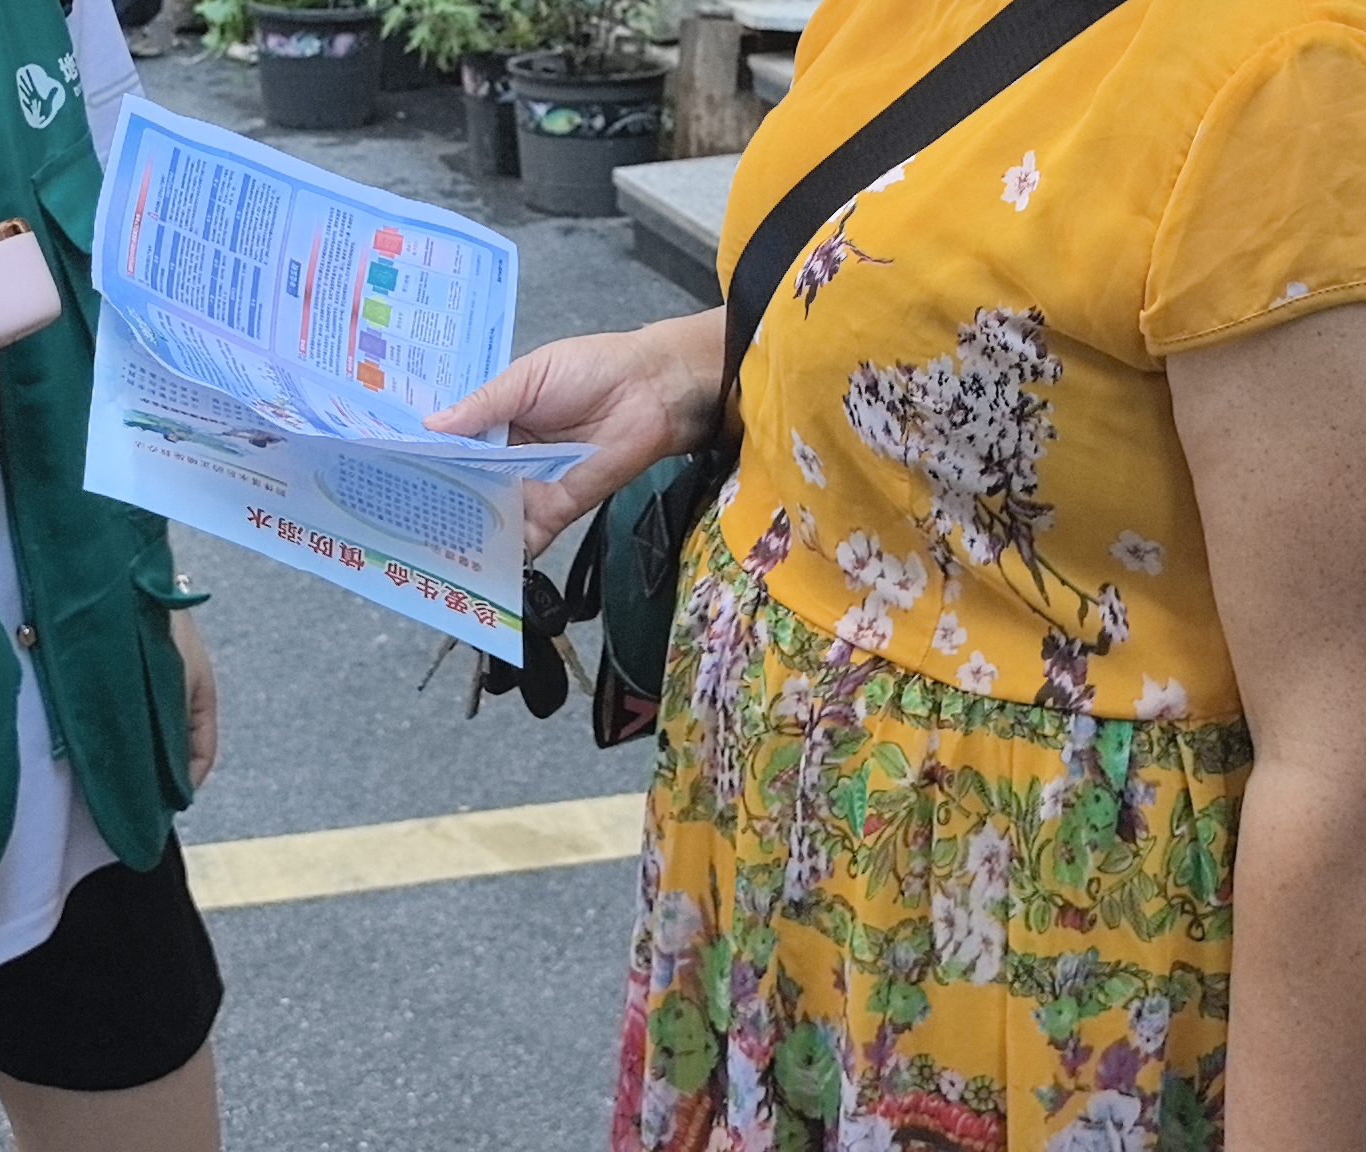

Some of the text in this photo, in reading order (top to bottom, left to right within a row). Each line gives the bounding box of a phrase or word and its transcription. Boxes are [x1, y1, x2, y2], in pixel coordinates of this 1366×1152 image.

[241, 503, 368, 571] 慎防溺水
[381, 559, 501, 628] 珍爱生命
